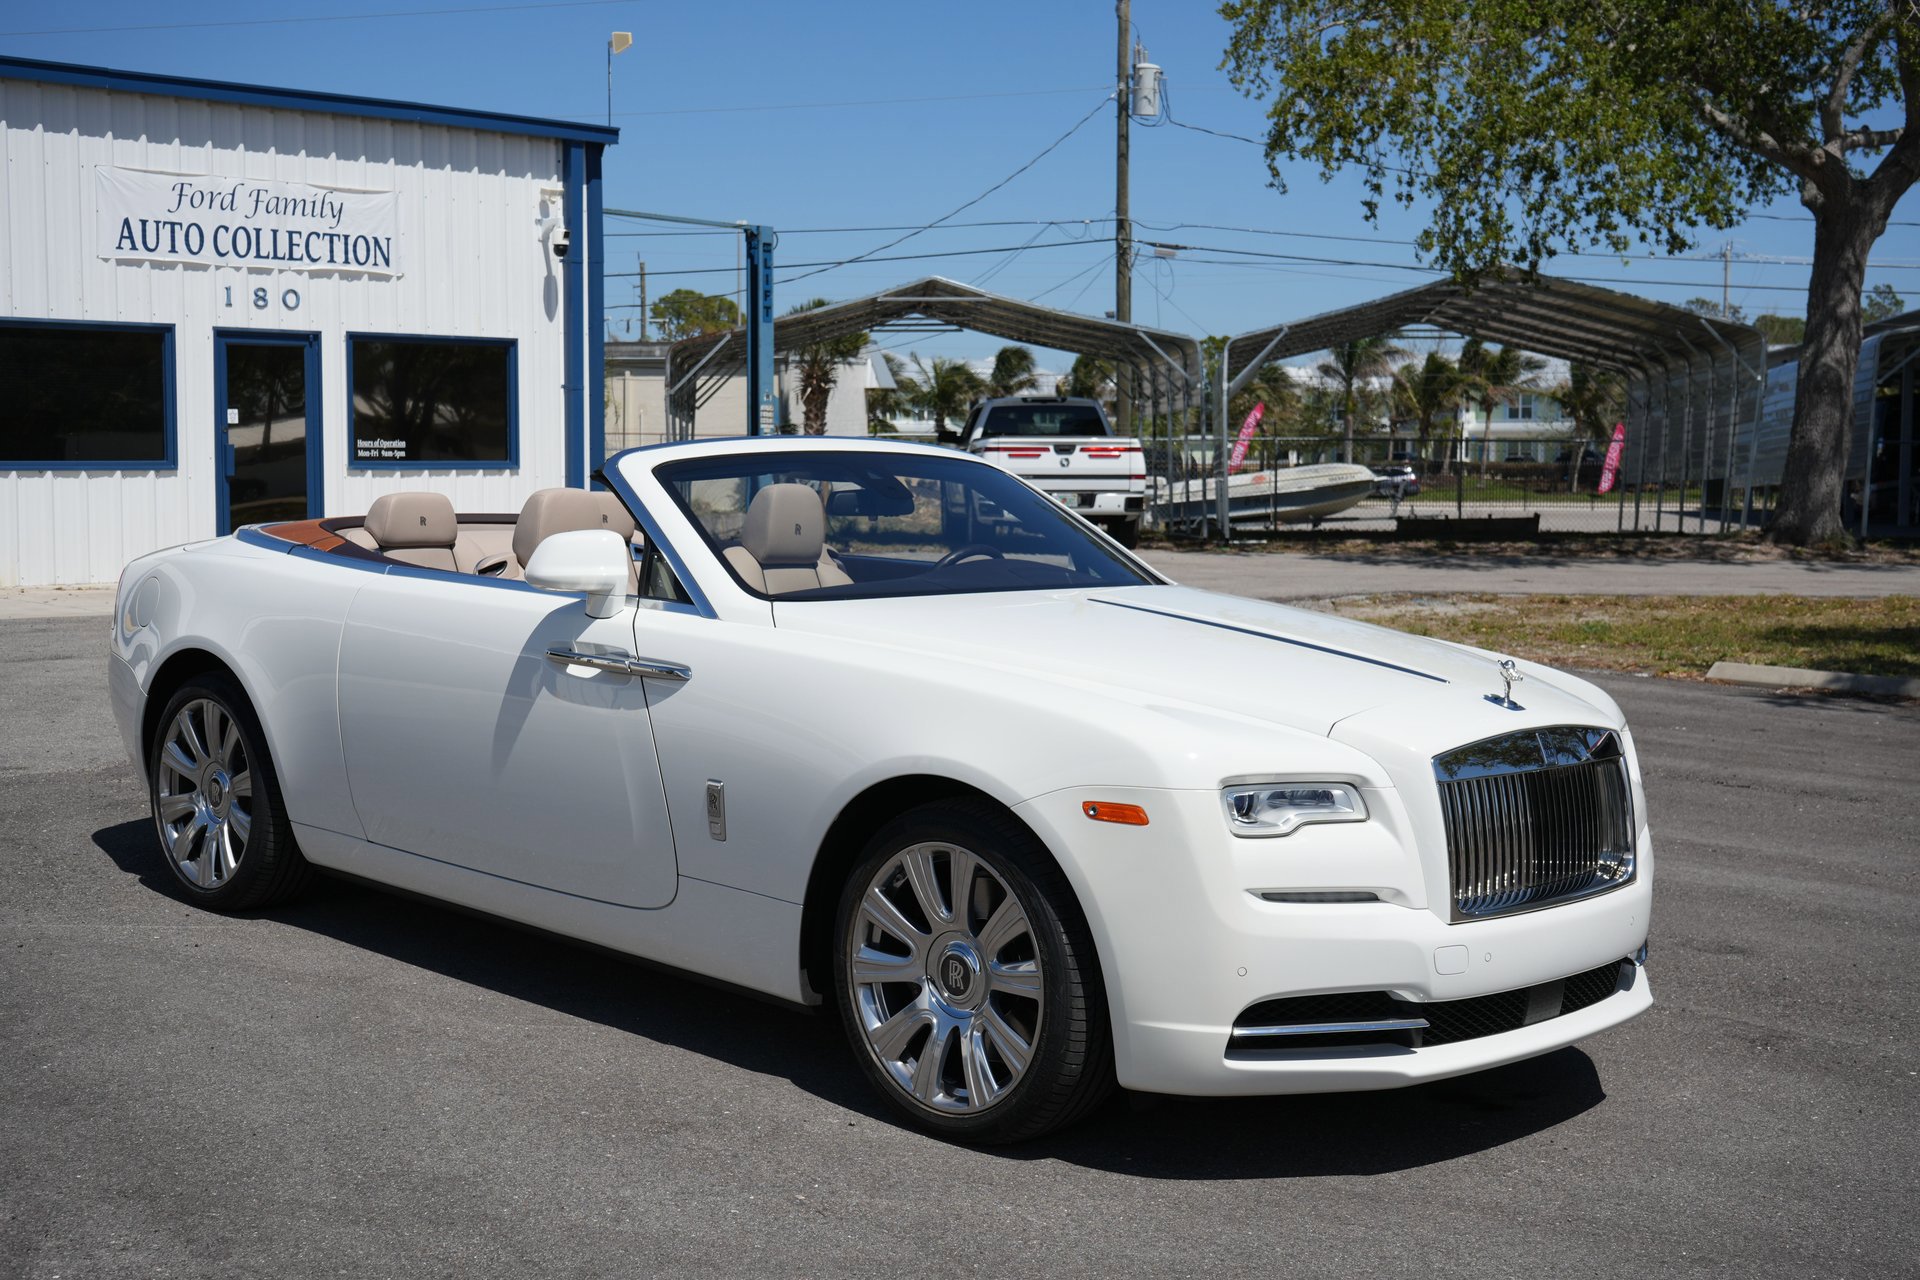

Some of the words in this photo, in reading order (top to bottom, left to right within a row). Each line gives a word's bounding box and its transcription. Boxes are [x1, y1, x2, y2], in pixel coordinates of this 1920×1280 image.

[167, 182, 244, 213] Ford
[245, 189, 344, 229] Family
[116, 217, 205, 256] AUTO
[212, 224, 391, 268] COLLECTION
[224, 286, 301, 311] 180
[763, 258, 772, 318] LIFT
[357, 439, 373, 448] Hours
[374, 438, 380, 448] of
[380, 439, 406, 449] Operation
[949, 959, 964, 990] RR
